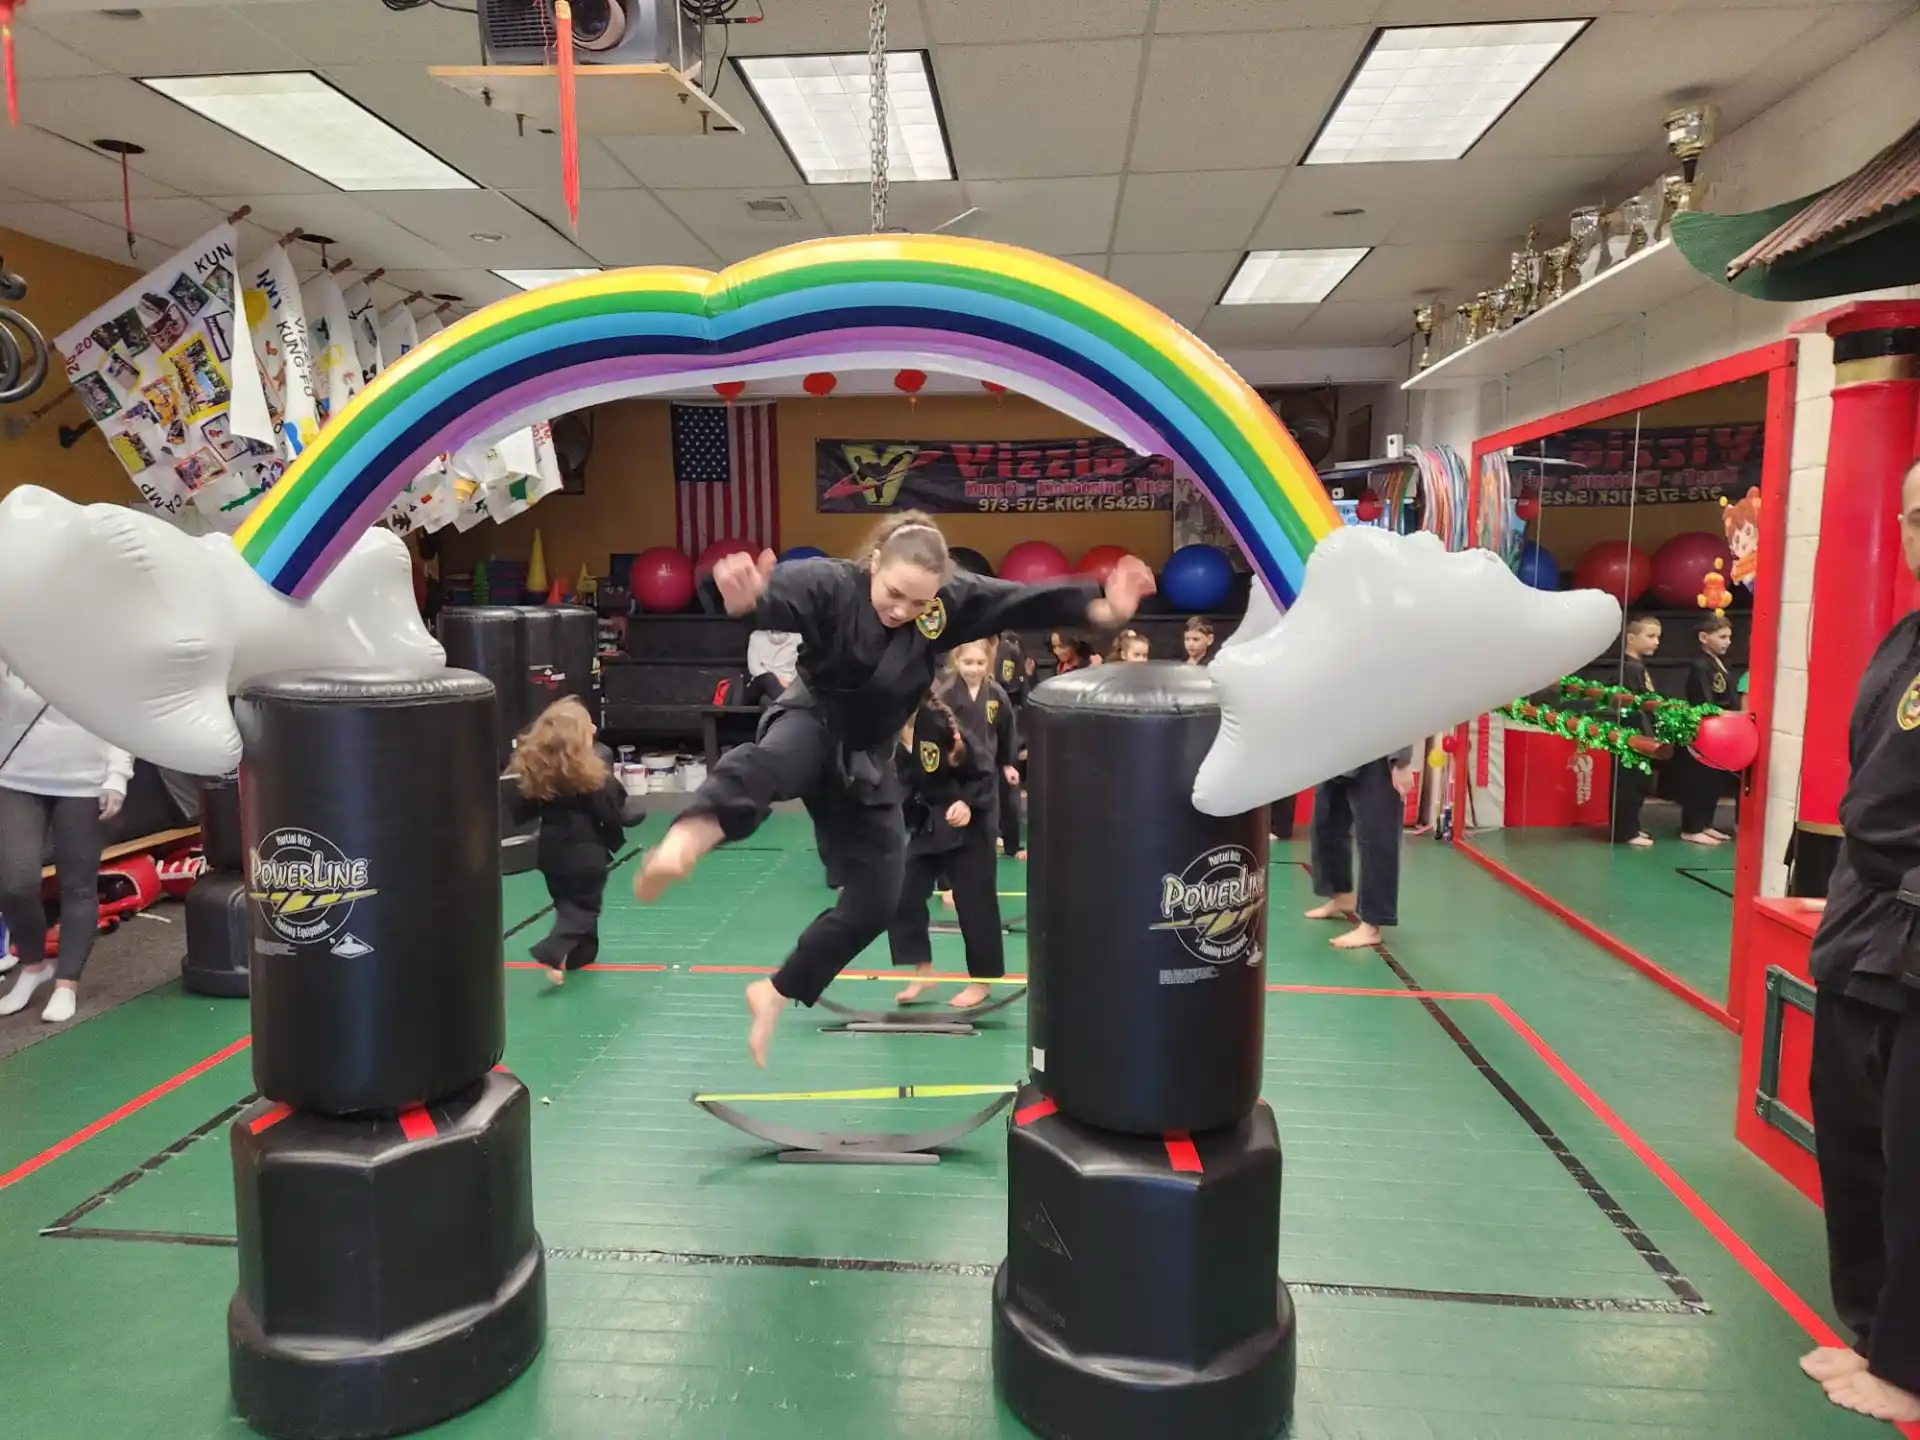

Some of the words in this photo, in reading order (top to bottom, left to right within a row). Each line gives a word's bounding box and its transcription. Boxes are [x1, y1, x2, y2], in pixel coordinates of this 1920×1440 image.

[194, 243, 233, 274] KUN
[67, 337, 92, 375] 2020
[141, 483, 182, 514] CAMP
[978, 497, 1096, 512] 973-575-KICK
[1098, 495, 1156, 511] (5425)
